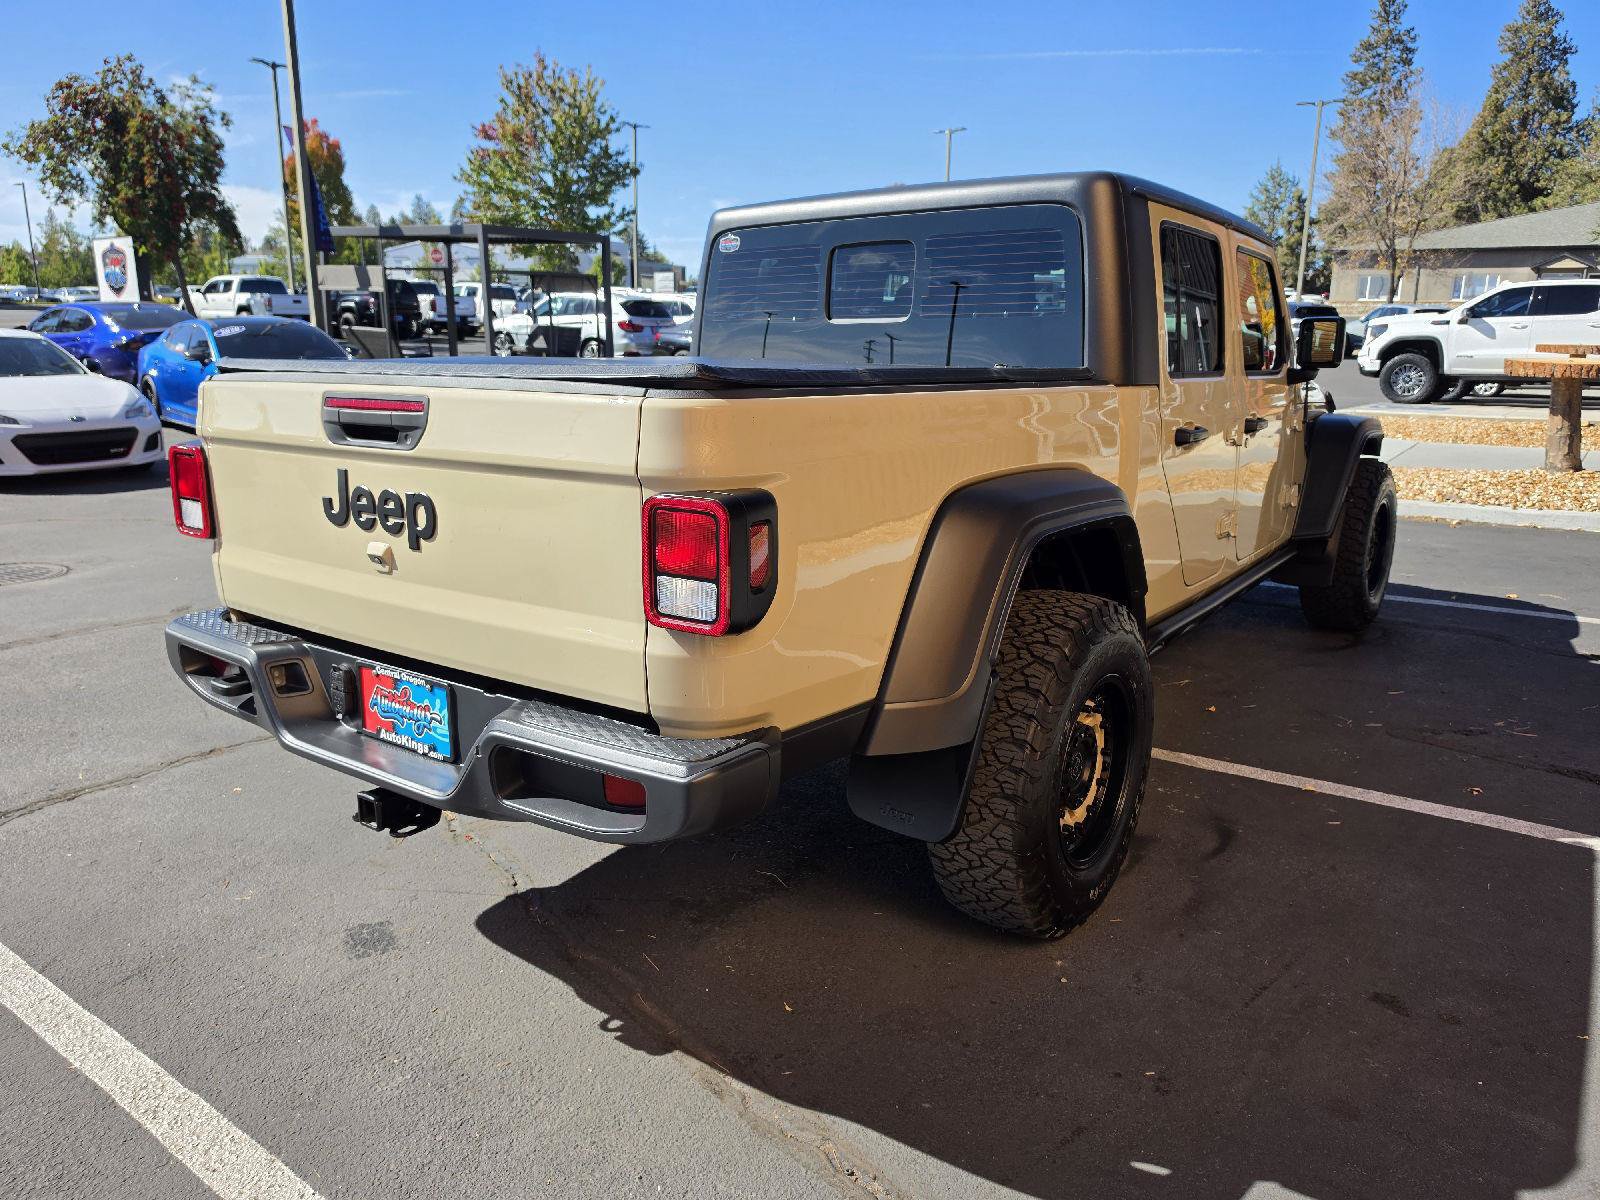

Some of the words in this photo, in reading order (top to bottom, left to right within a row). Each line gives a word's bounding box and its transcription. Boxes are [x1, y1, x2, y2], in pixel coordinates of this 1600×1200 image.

[322, 468, 437, 552] Jeep
[376, 666, 400, 680] Central
[401, 672, 426, 686] Oregon
